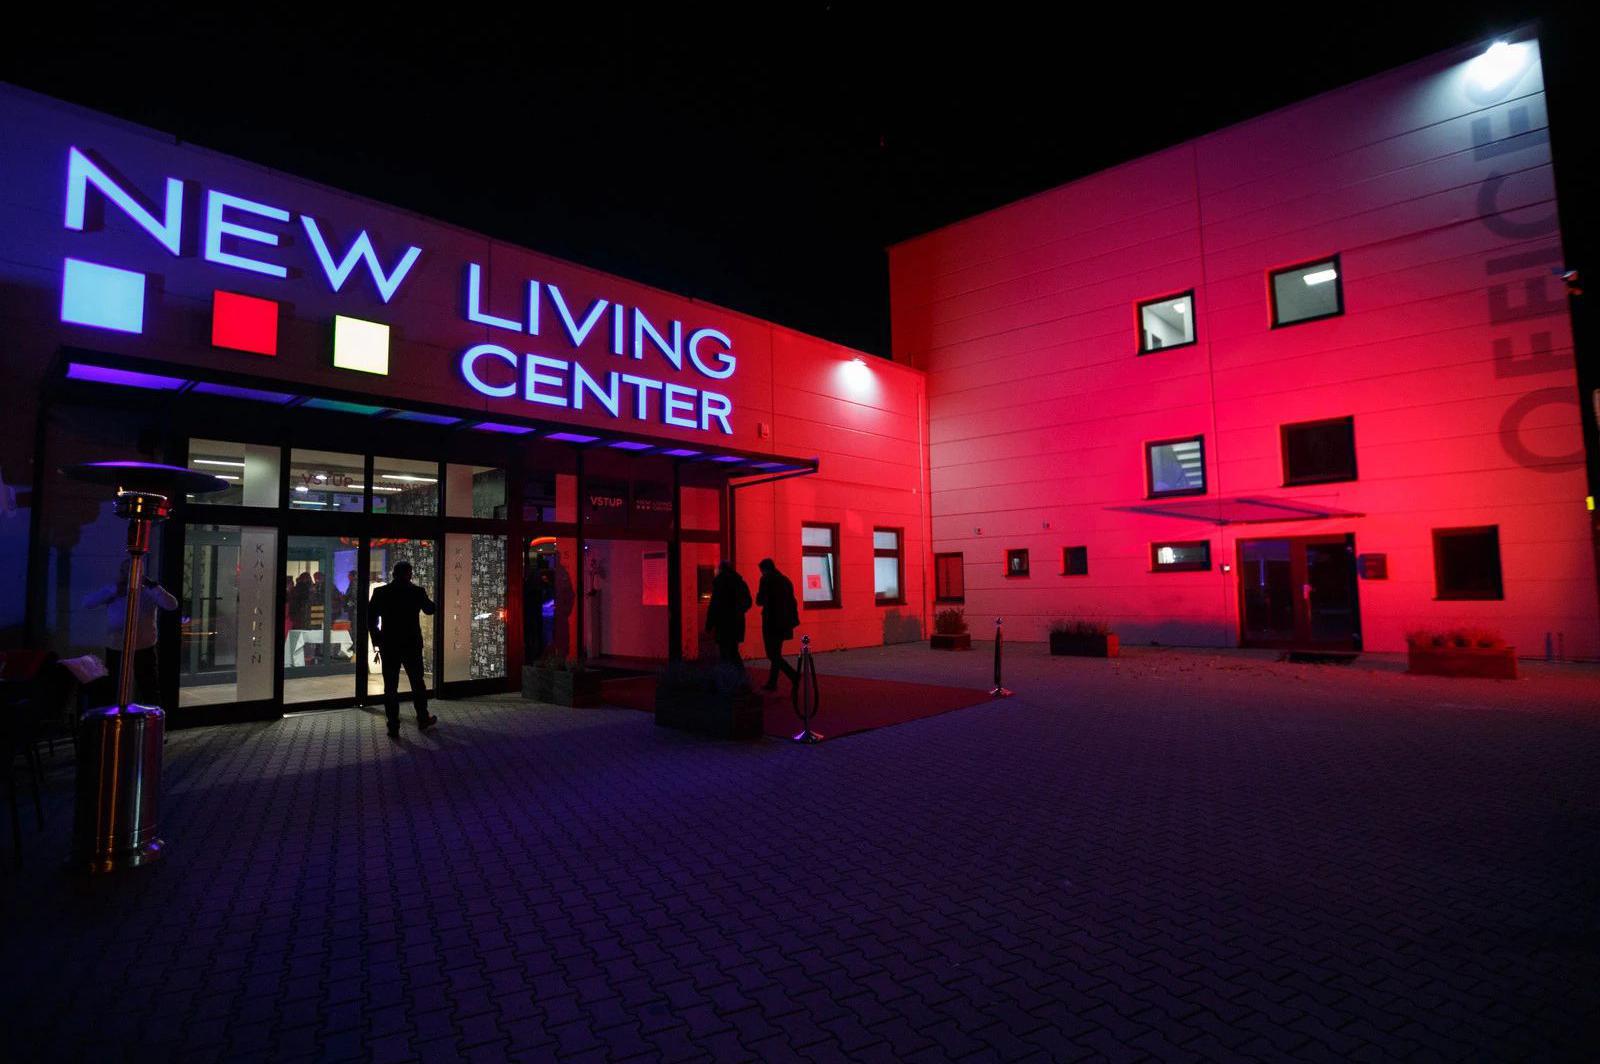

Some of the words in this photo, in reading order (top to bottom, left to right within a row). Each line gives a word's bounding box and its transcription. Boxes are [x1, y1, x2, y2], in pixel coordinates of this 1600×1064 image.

[64, 145, 422, 304] NEW
[468, 262, 737, 379] LIVING
[461, 344, 733, 434] CENTER
[302, 472, 354, 488] VSTUP
[590, 495, 623, 508] VSTUP
